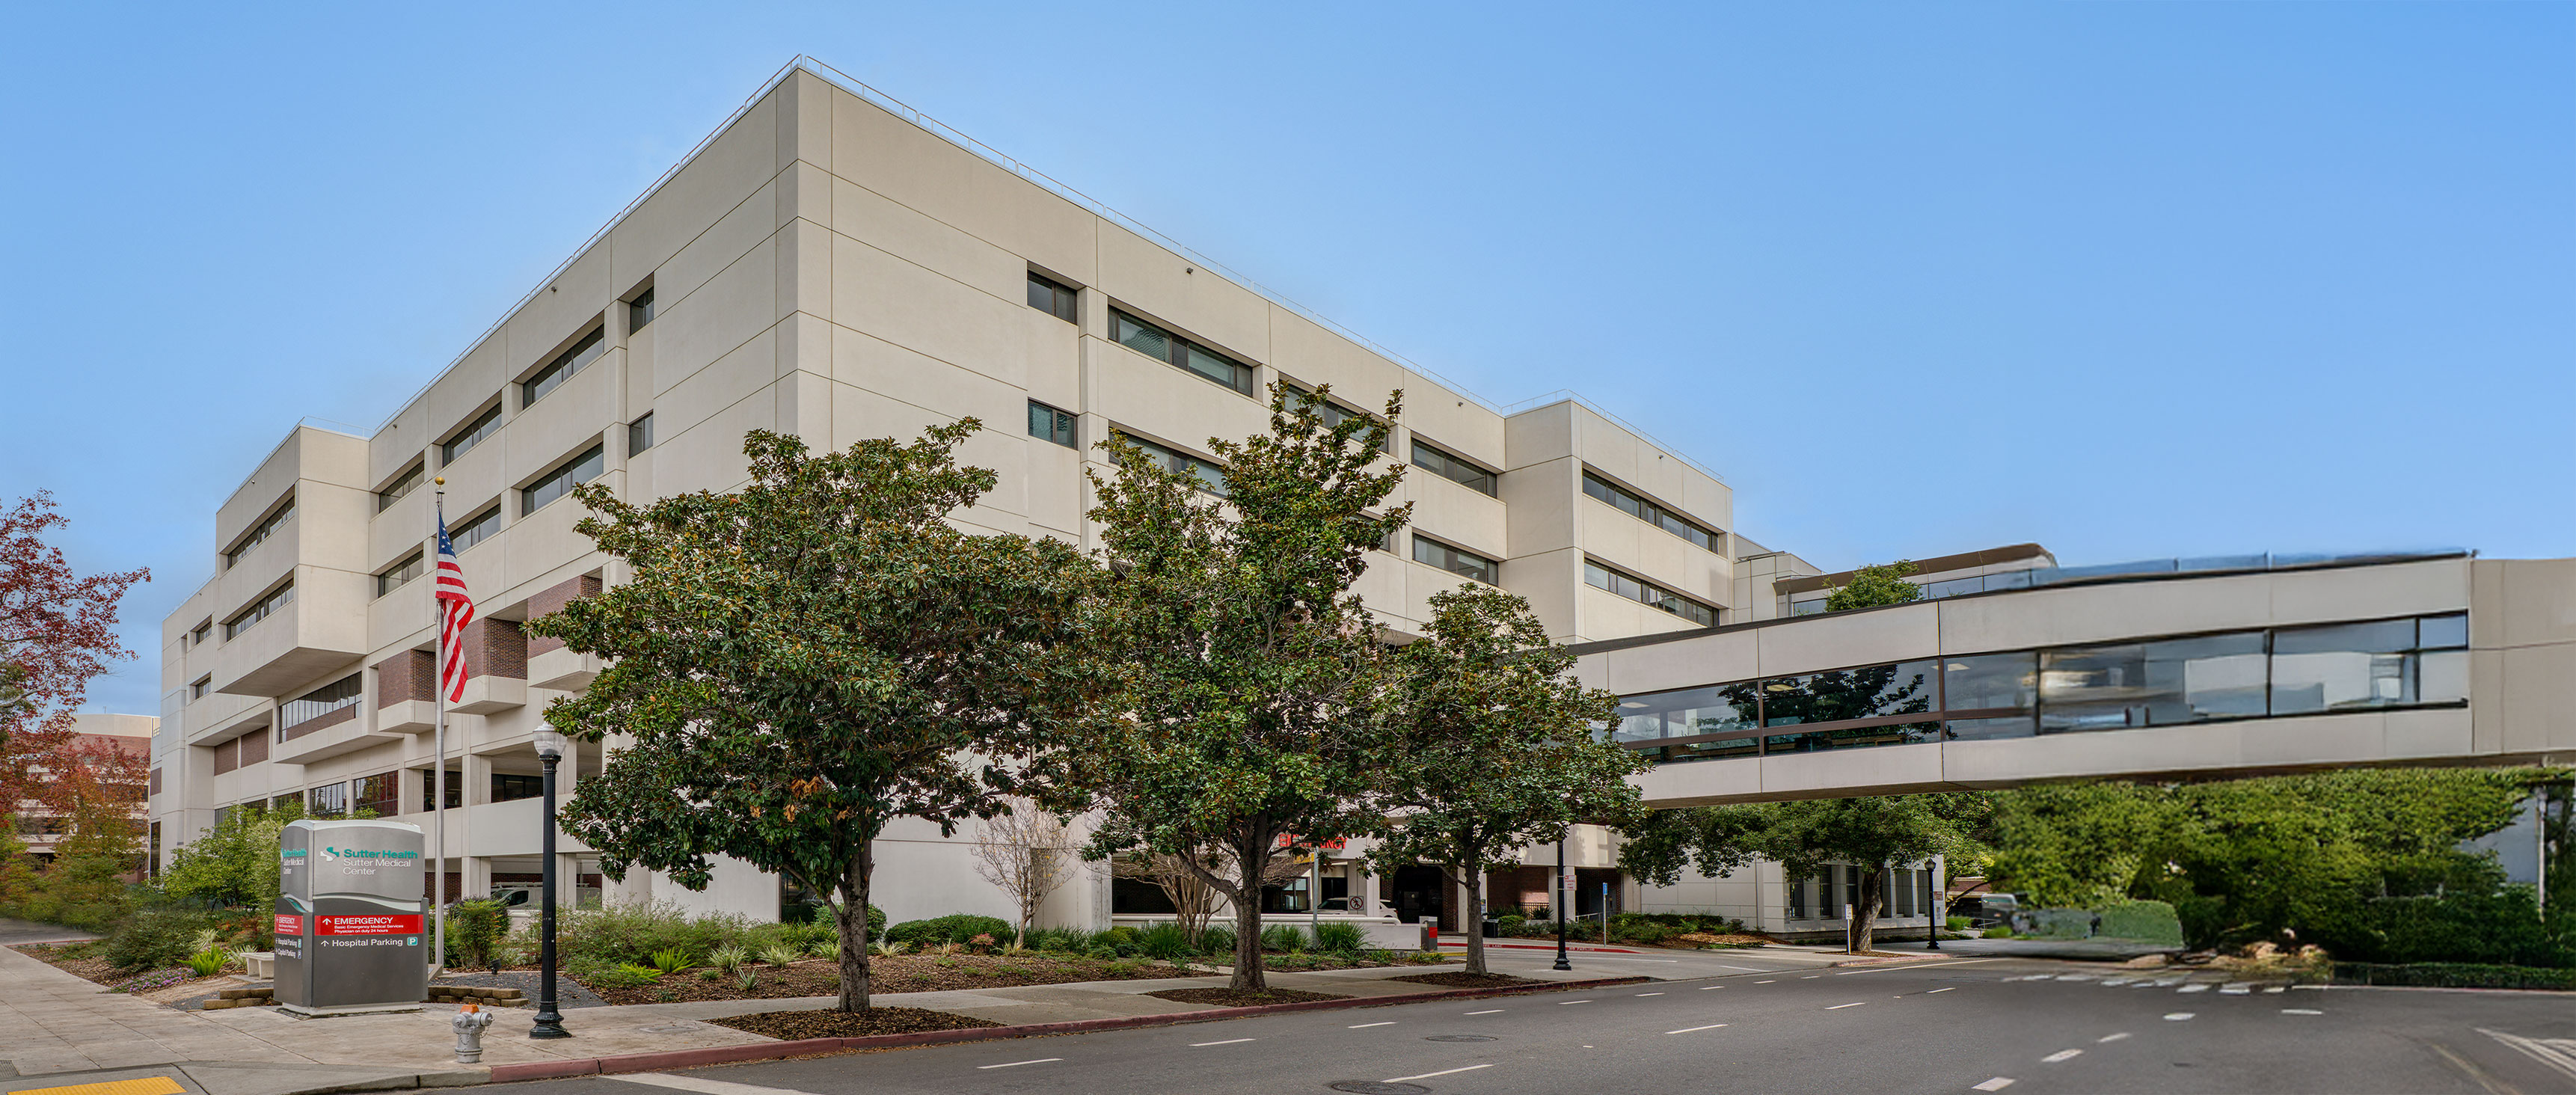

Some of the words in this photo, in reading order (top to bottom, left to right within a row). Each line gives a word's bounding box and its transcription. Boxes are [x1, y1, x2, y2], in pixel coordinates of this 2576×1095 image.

[343, 849, 381, 858] Sutter
[382, 850, 418, 859] Health
[343, 858, 373, 867] Sutter
[375, 859, 411, 867] Medical
[343, 867, 376, 875] Center
[334, 917, 393, 925] EMERGENCY
[332, 939, 369, 948] Hospital
[370, 938, 403, 947] Parking
